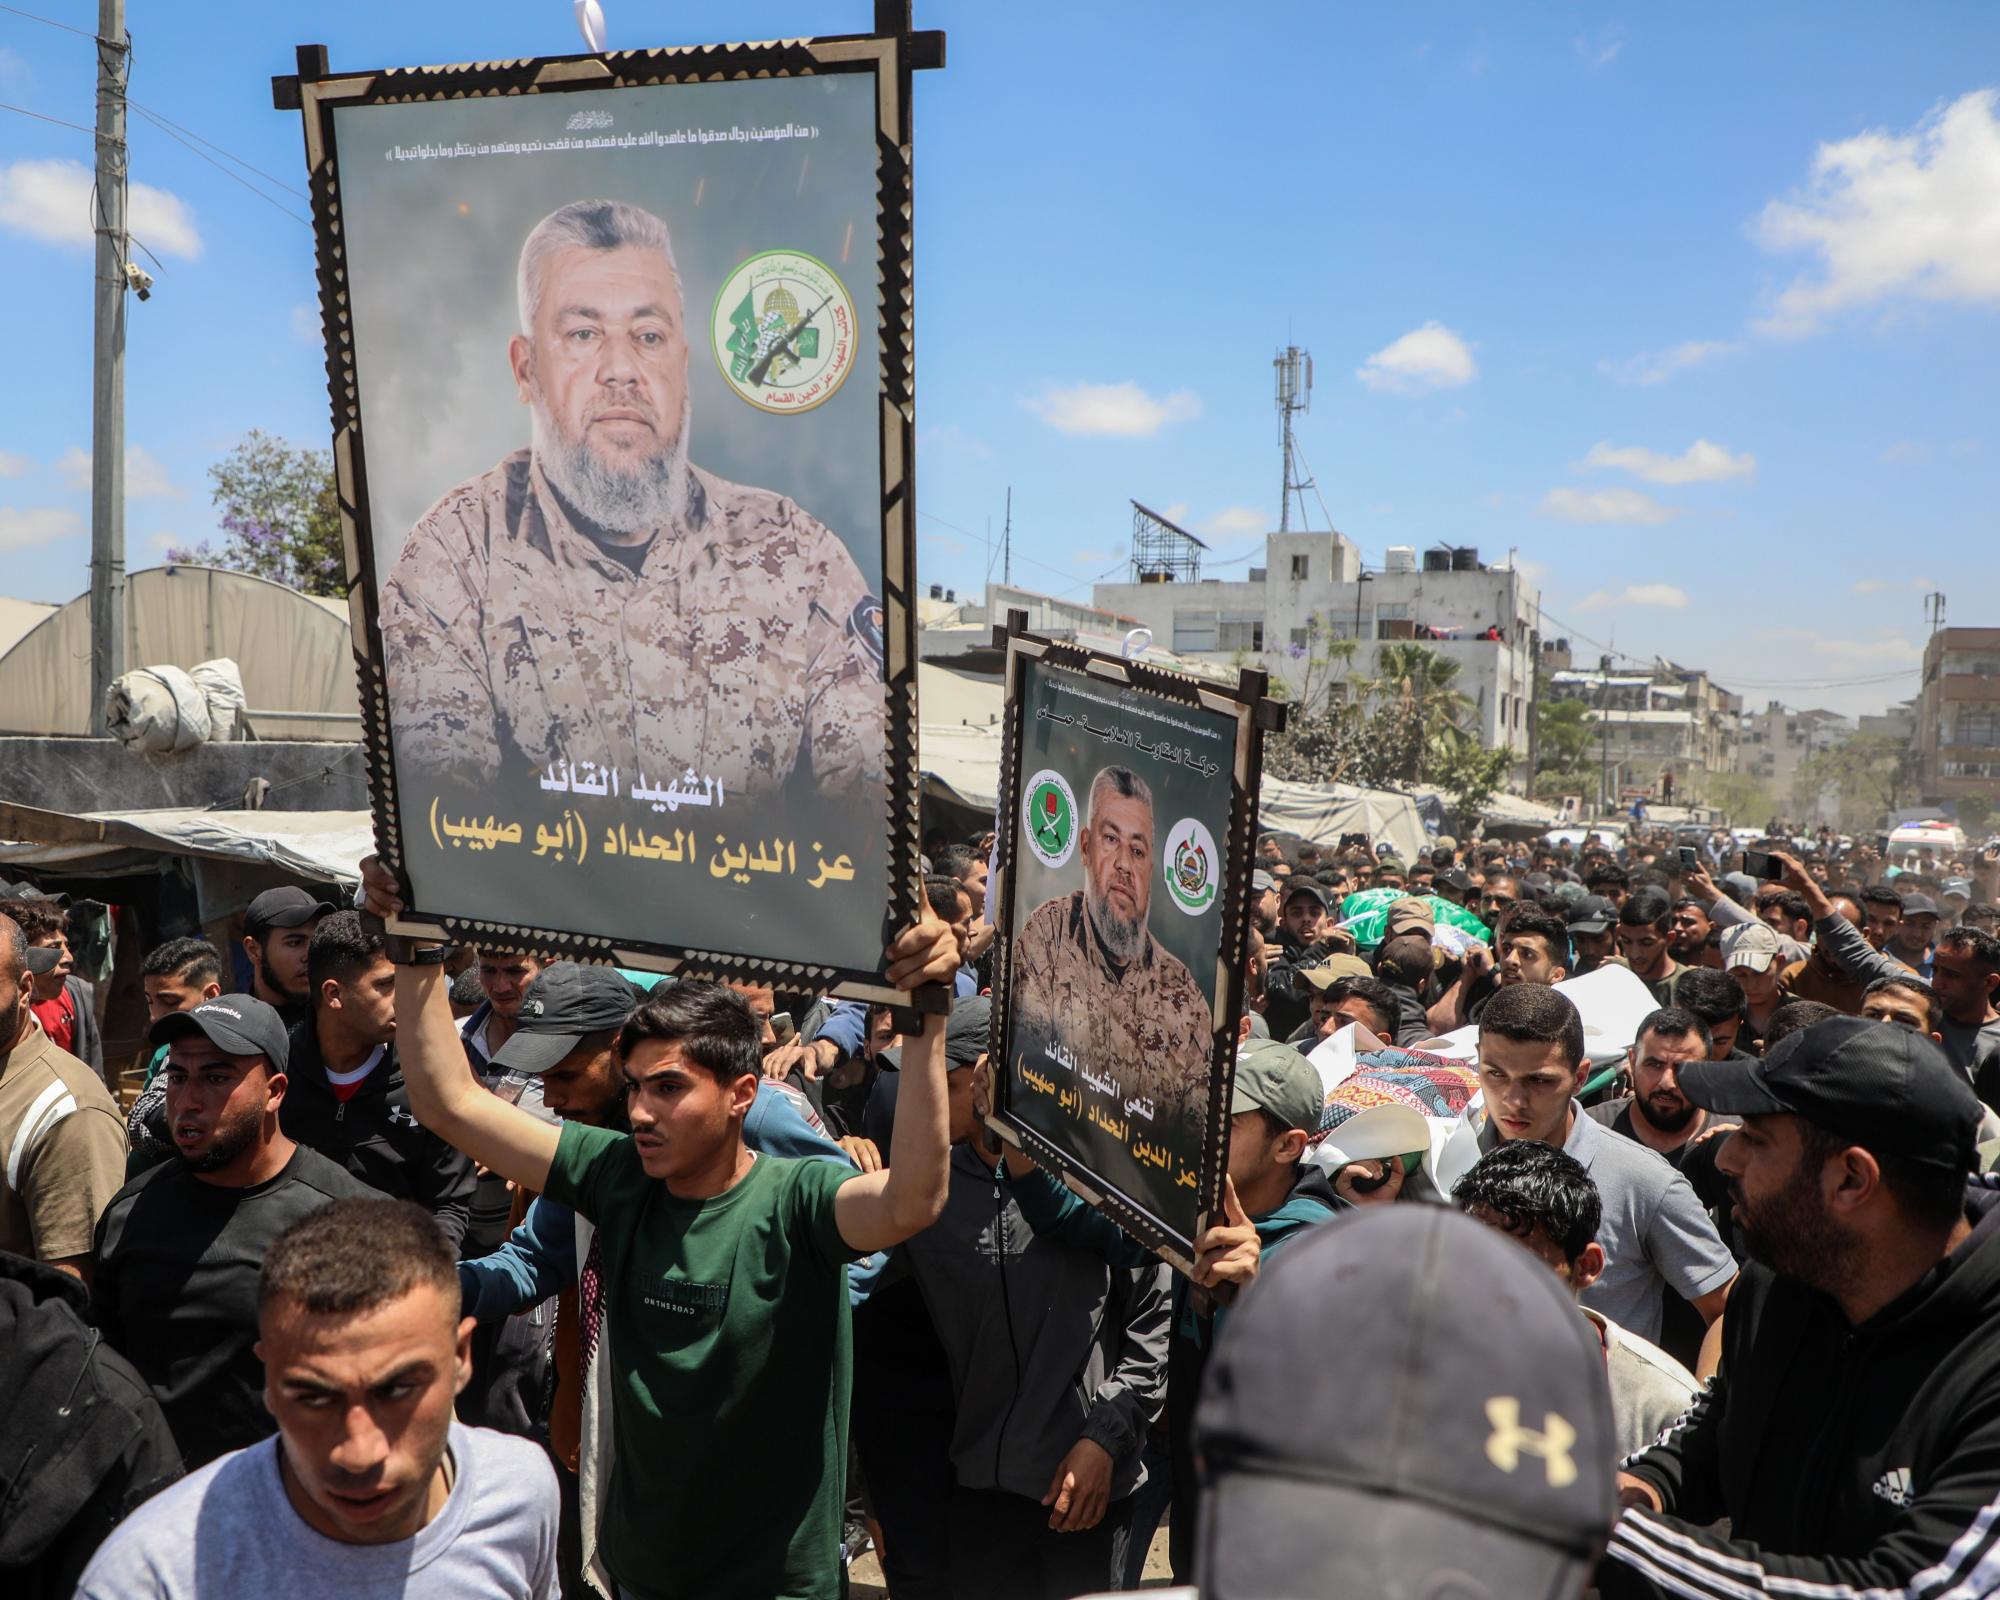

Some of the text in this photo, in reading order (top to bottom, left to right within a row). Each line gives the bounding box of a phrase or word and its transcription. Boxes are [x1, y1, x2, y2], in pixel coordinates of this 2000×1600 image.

[639, 130, 654, 145] الله
[655, 129, 686, 147] عاهدوا
[687, 129, 697, 143] ما
[699, 128, 727, 144] صدقوا
[728, 126, 749, 143] رجال
[750, 123, 793, 142] المؤمنين
[795, 125, 808, 137] من
[454, 141, 476, 158] ينتظر
[491, 141, 520, 154] ومنهم
[521, 139, 541, 154] نحبه
[571, 137, 584, 149] من
[585, 135, 616, 149] فمنهم
[617, 132, 637, 149] عليه
[766, 393, 795, 404] القسام
[1036, 704, 1074, 725] حماس
[1135, 732, 1181, 764] المقاومة
[1184, 748, 1219, 777] حركة
[540, 759, 724, 813] الشهيد القائد
[604, 823, 695, 864] الحداد
[710, 834, 796, 885] الدين
[807, 841, 856, 889] عز
[1045, 1041, 1077, 1072] القائد
[1082, 1064, 1120, 1099] الشهيد
[1088, 1105, 1128, 1144] الحداد
[1133, 1132, 1171, 1171] الدين
[1175, 1157, 1197, 1189] عز
